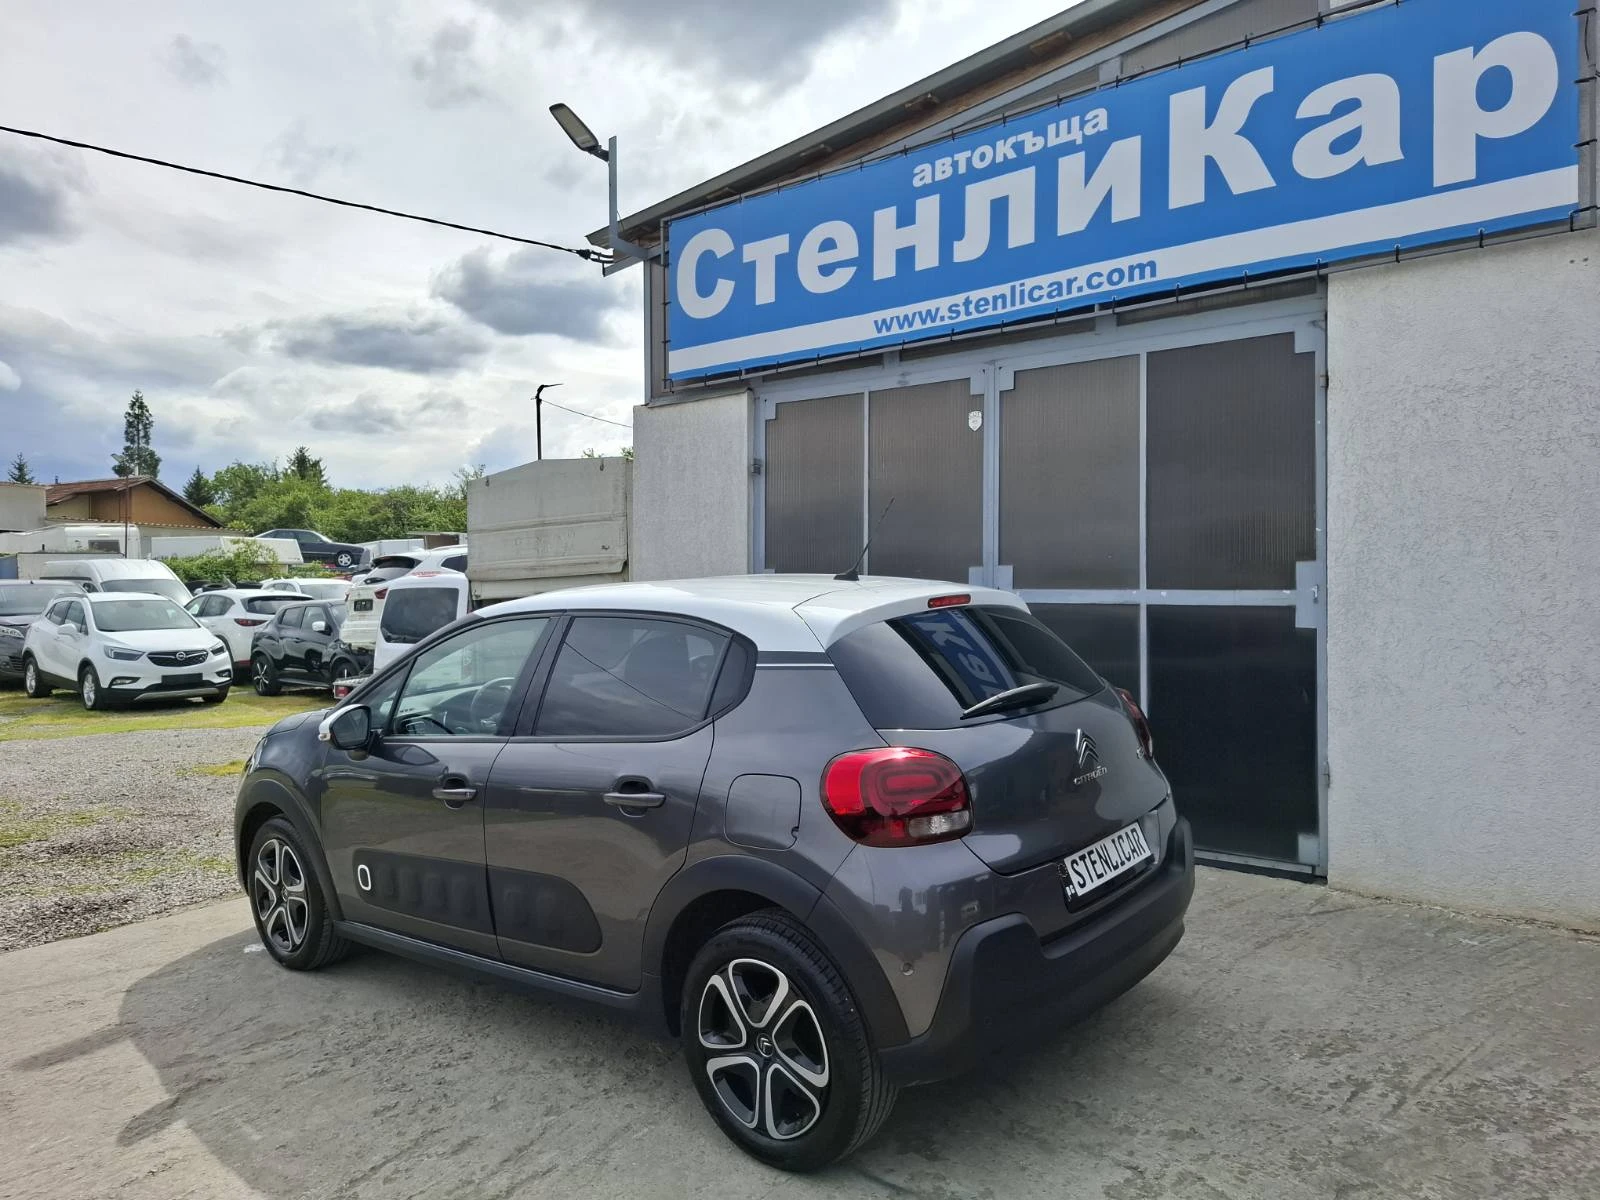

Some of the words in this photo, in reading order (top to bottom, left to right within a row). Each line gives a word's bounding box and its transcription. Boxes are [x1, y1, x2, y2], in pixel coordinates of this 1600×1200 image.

[676, 31, 1558, 319] СтенлиКар
[912, 107, 1108, 187] автокъща
[874, 260, 1157, 334] www.stenlicar.com
[1070, 827, 1146, 889] STENLICAR
